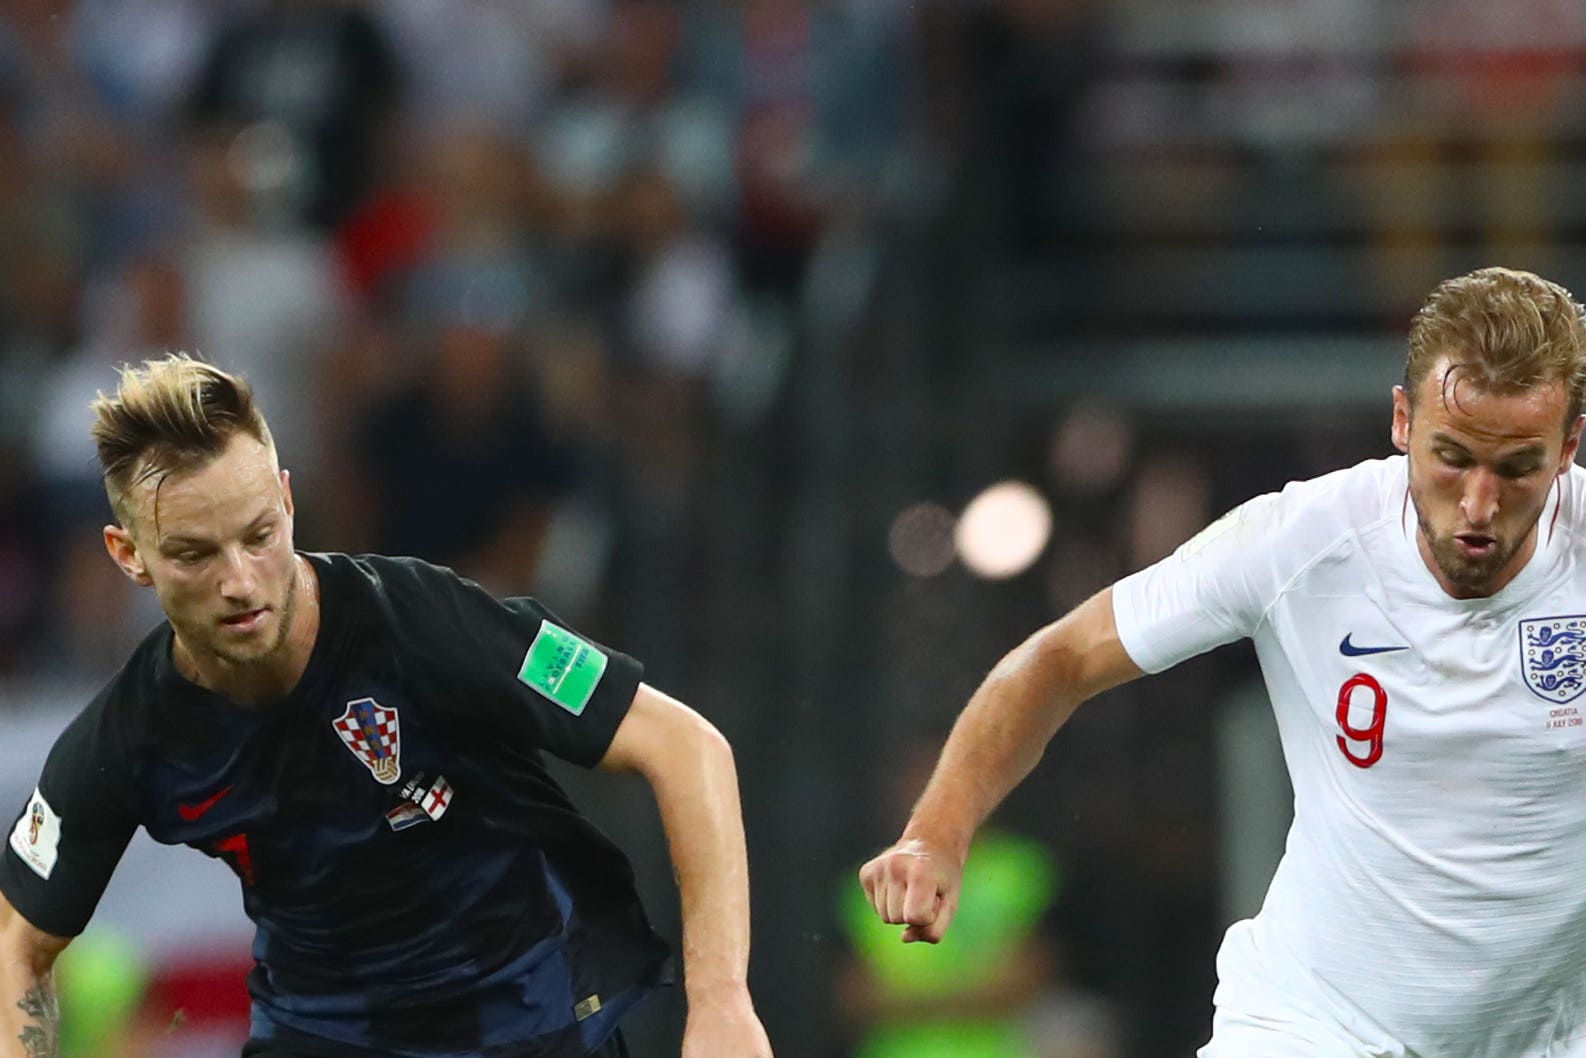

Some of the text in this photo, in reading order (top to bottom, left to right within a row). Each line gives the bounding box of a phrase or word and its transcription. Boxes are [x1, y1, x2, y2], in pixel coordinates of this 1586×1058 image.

[1335, 672, 1388, 769] 9
[1550, 708, 1578, 717] CROATIA
[1553, 719, 1566, 728] JULY
[216, 833, 256, 886] 7
